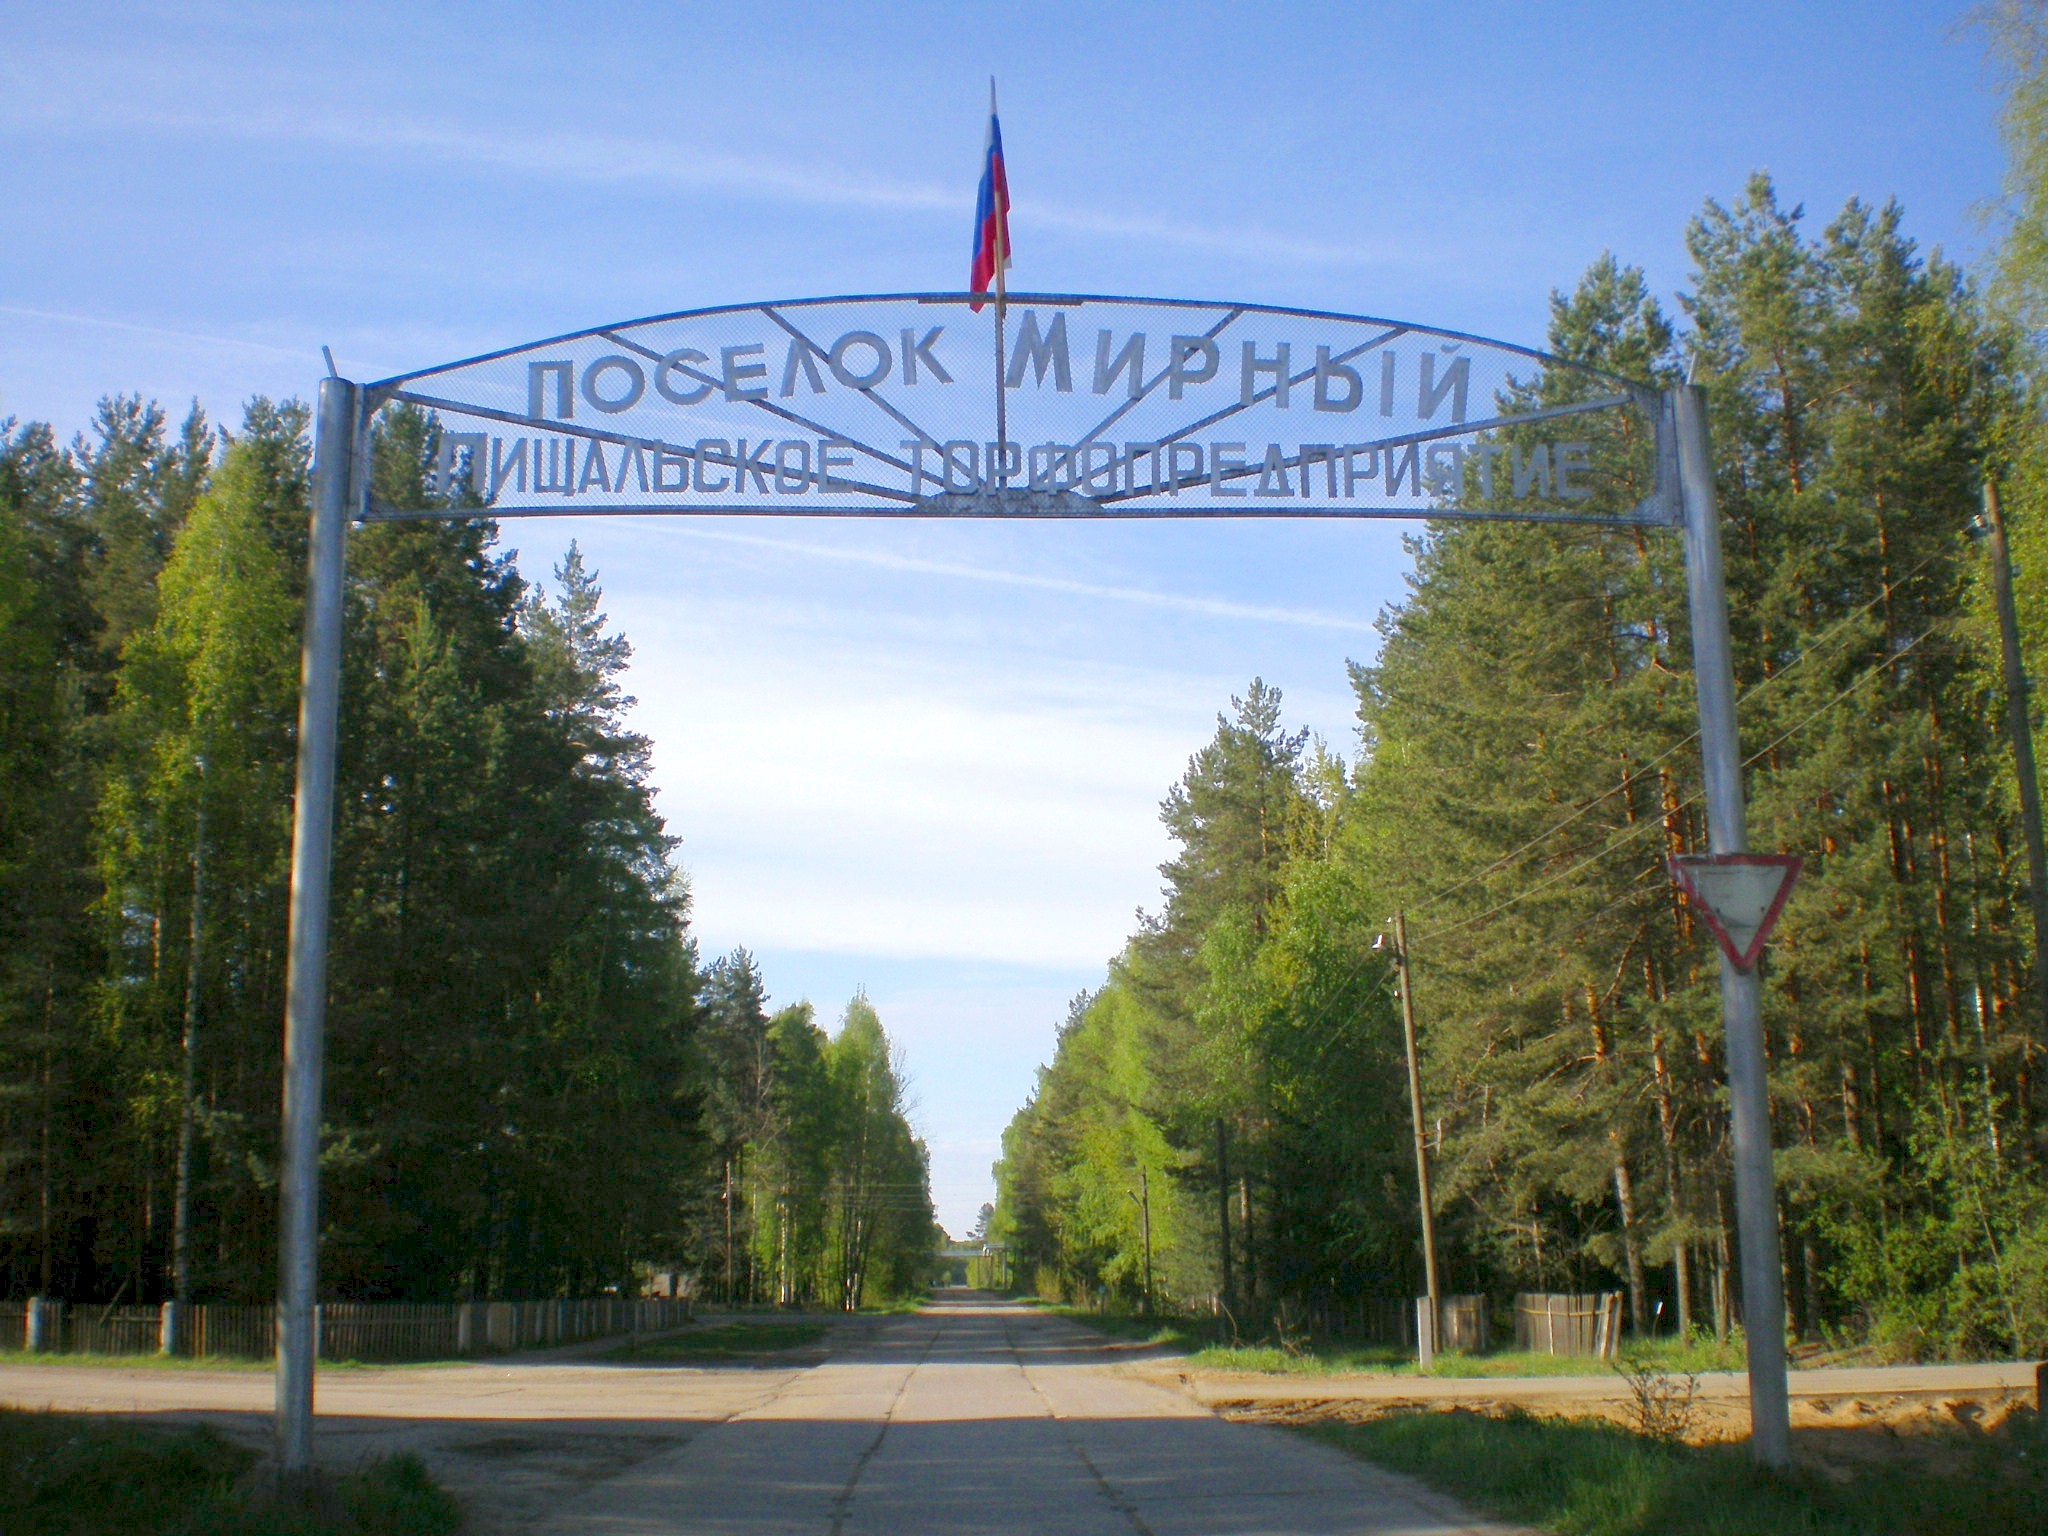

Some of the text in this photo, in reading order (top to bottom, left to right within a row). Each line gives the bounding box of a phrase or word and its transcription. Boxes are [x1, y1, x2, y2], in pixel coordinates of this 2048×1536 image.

[528, 310, 1471, 424] ПОСЕЛОК МИРНЫЙ
[437, 432, 1594, 501] ПИЩАЛЬСКОЕ ТОРФОПРЕДПРИЯТИЕ
